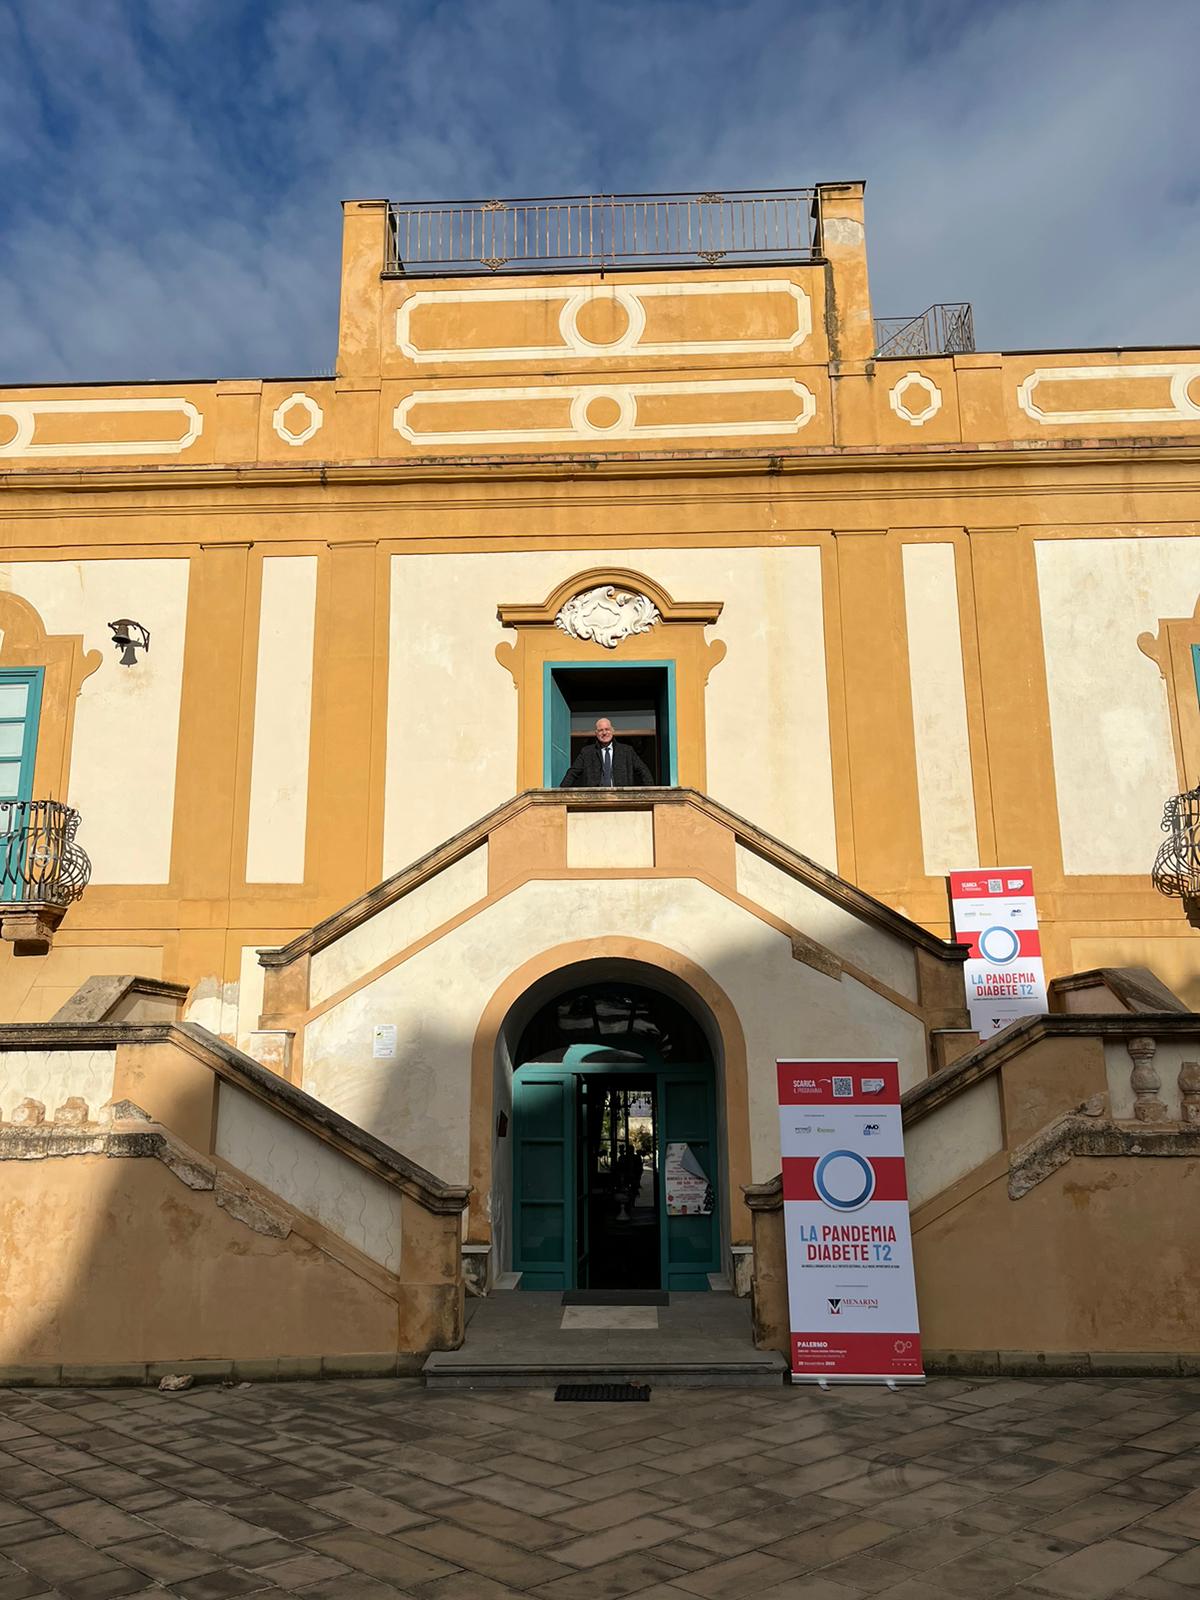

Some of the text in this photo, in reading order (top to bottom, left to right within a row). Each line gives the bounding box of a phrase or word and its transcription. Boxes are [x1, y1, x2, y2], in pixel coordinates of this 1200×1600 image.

[971, 972, 1036, 985] LA PANDEMIA
[976, 984, 1034, 996] DIABETE T2
[793, 1080, 816, 1088] SCARICA
[800, 1225, 897, 1242] LA PANDEMIA
[807, 1244, 892, 1261] DIABETE T2
